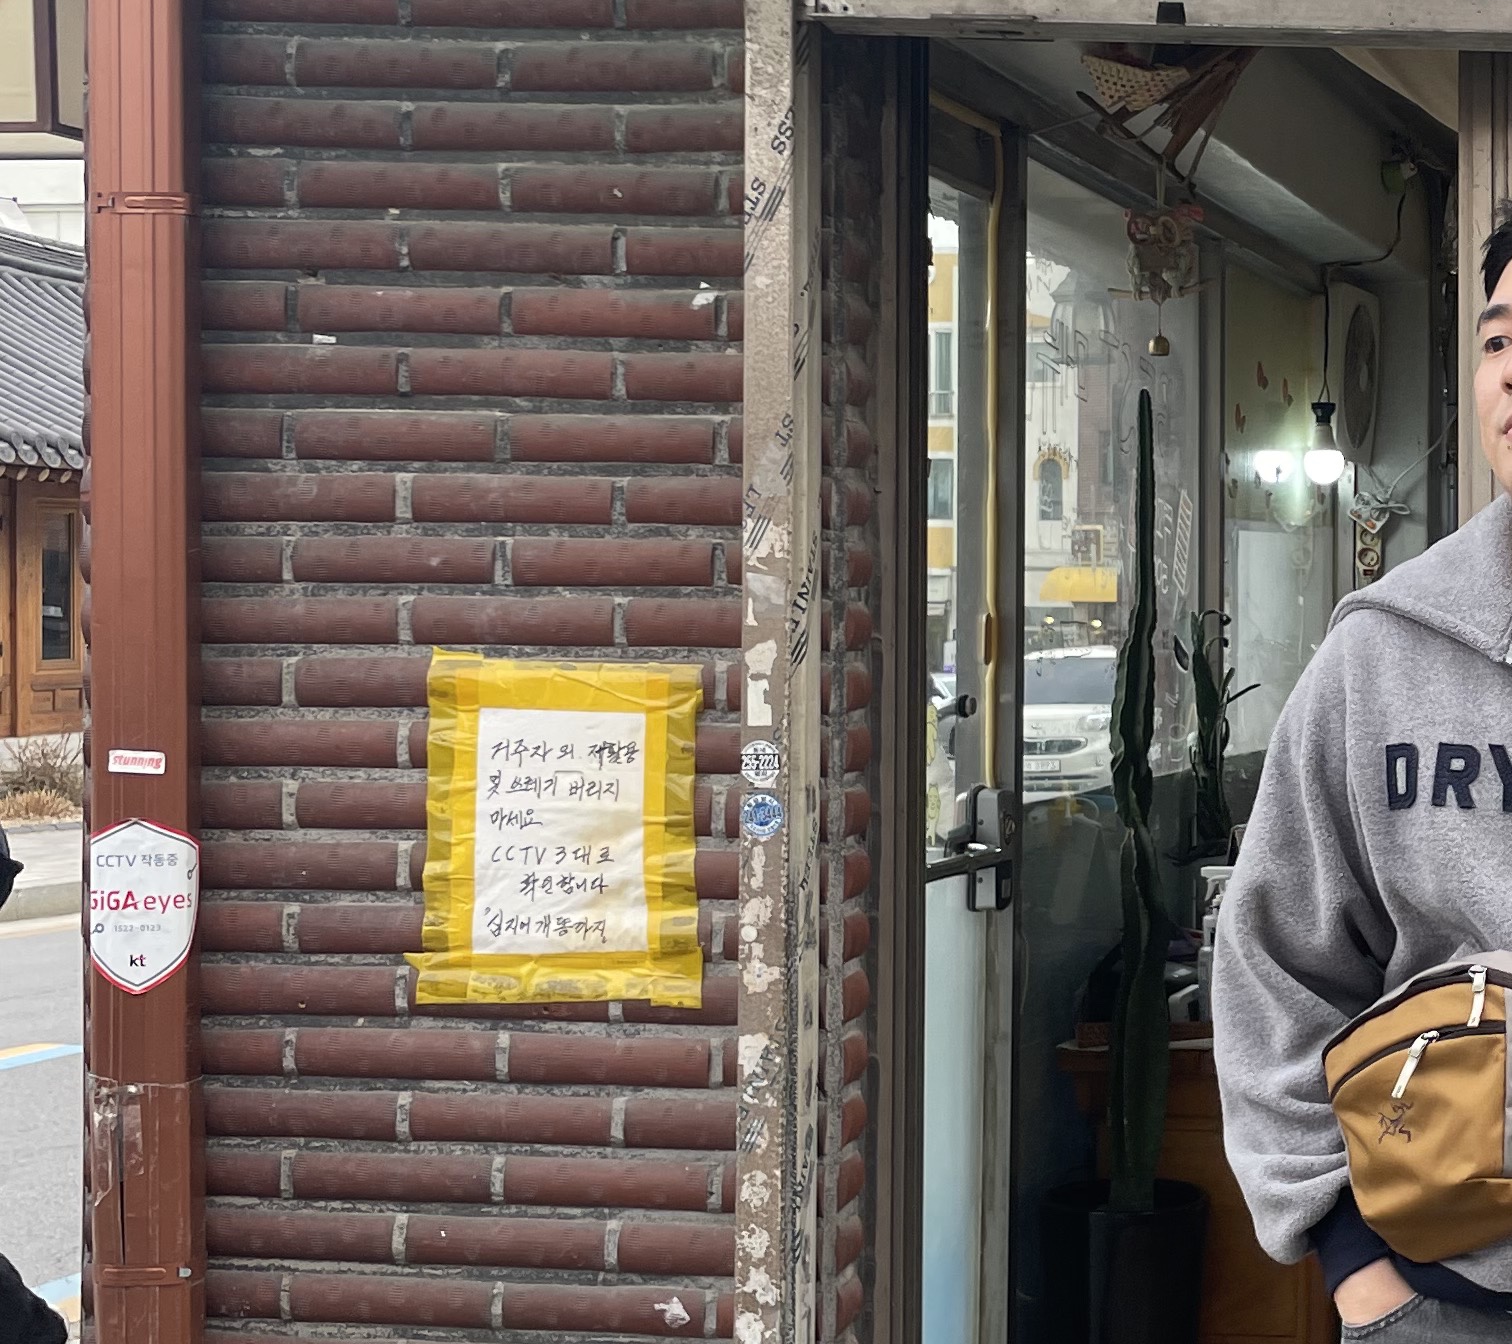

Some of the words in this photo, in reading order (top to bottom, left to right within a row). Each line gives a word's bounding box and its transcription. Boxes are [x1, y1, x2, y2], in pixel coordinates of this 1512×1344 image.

[112, 755, 162, 769] stunning
[568, 775, 620, 802] 버리지
[489, 807, 544, 832] 마세요
[96, 855, 137, 867] CCTV
[141, 853, 179, 867] 작동중
[491, 845, 548, 866] CCTV
[519, 872, 610, 902] 확인합니다
[143, 893, 192, 915] eyes
[113, 924, 162, 933] 1522-0123
[129, 954, 147, 967] kt
